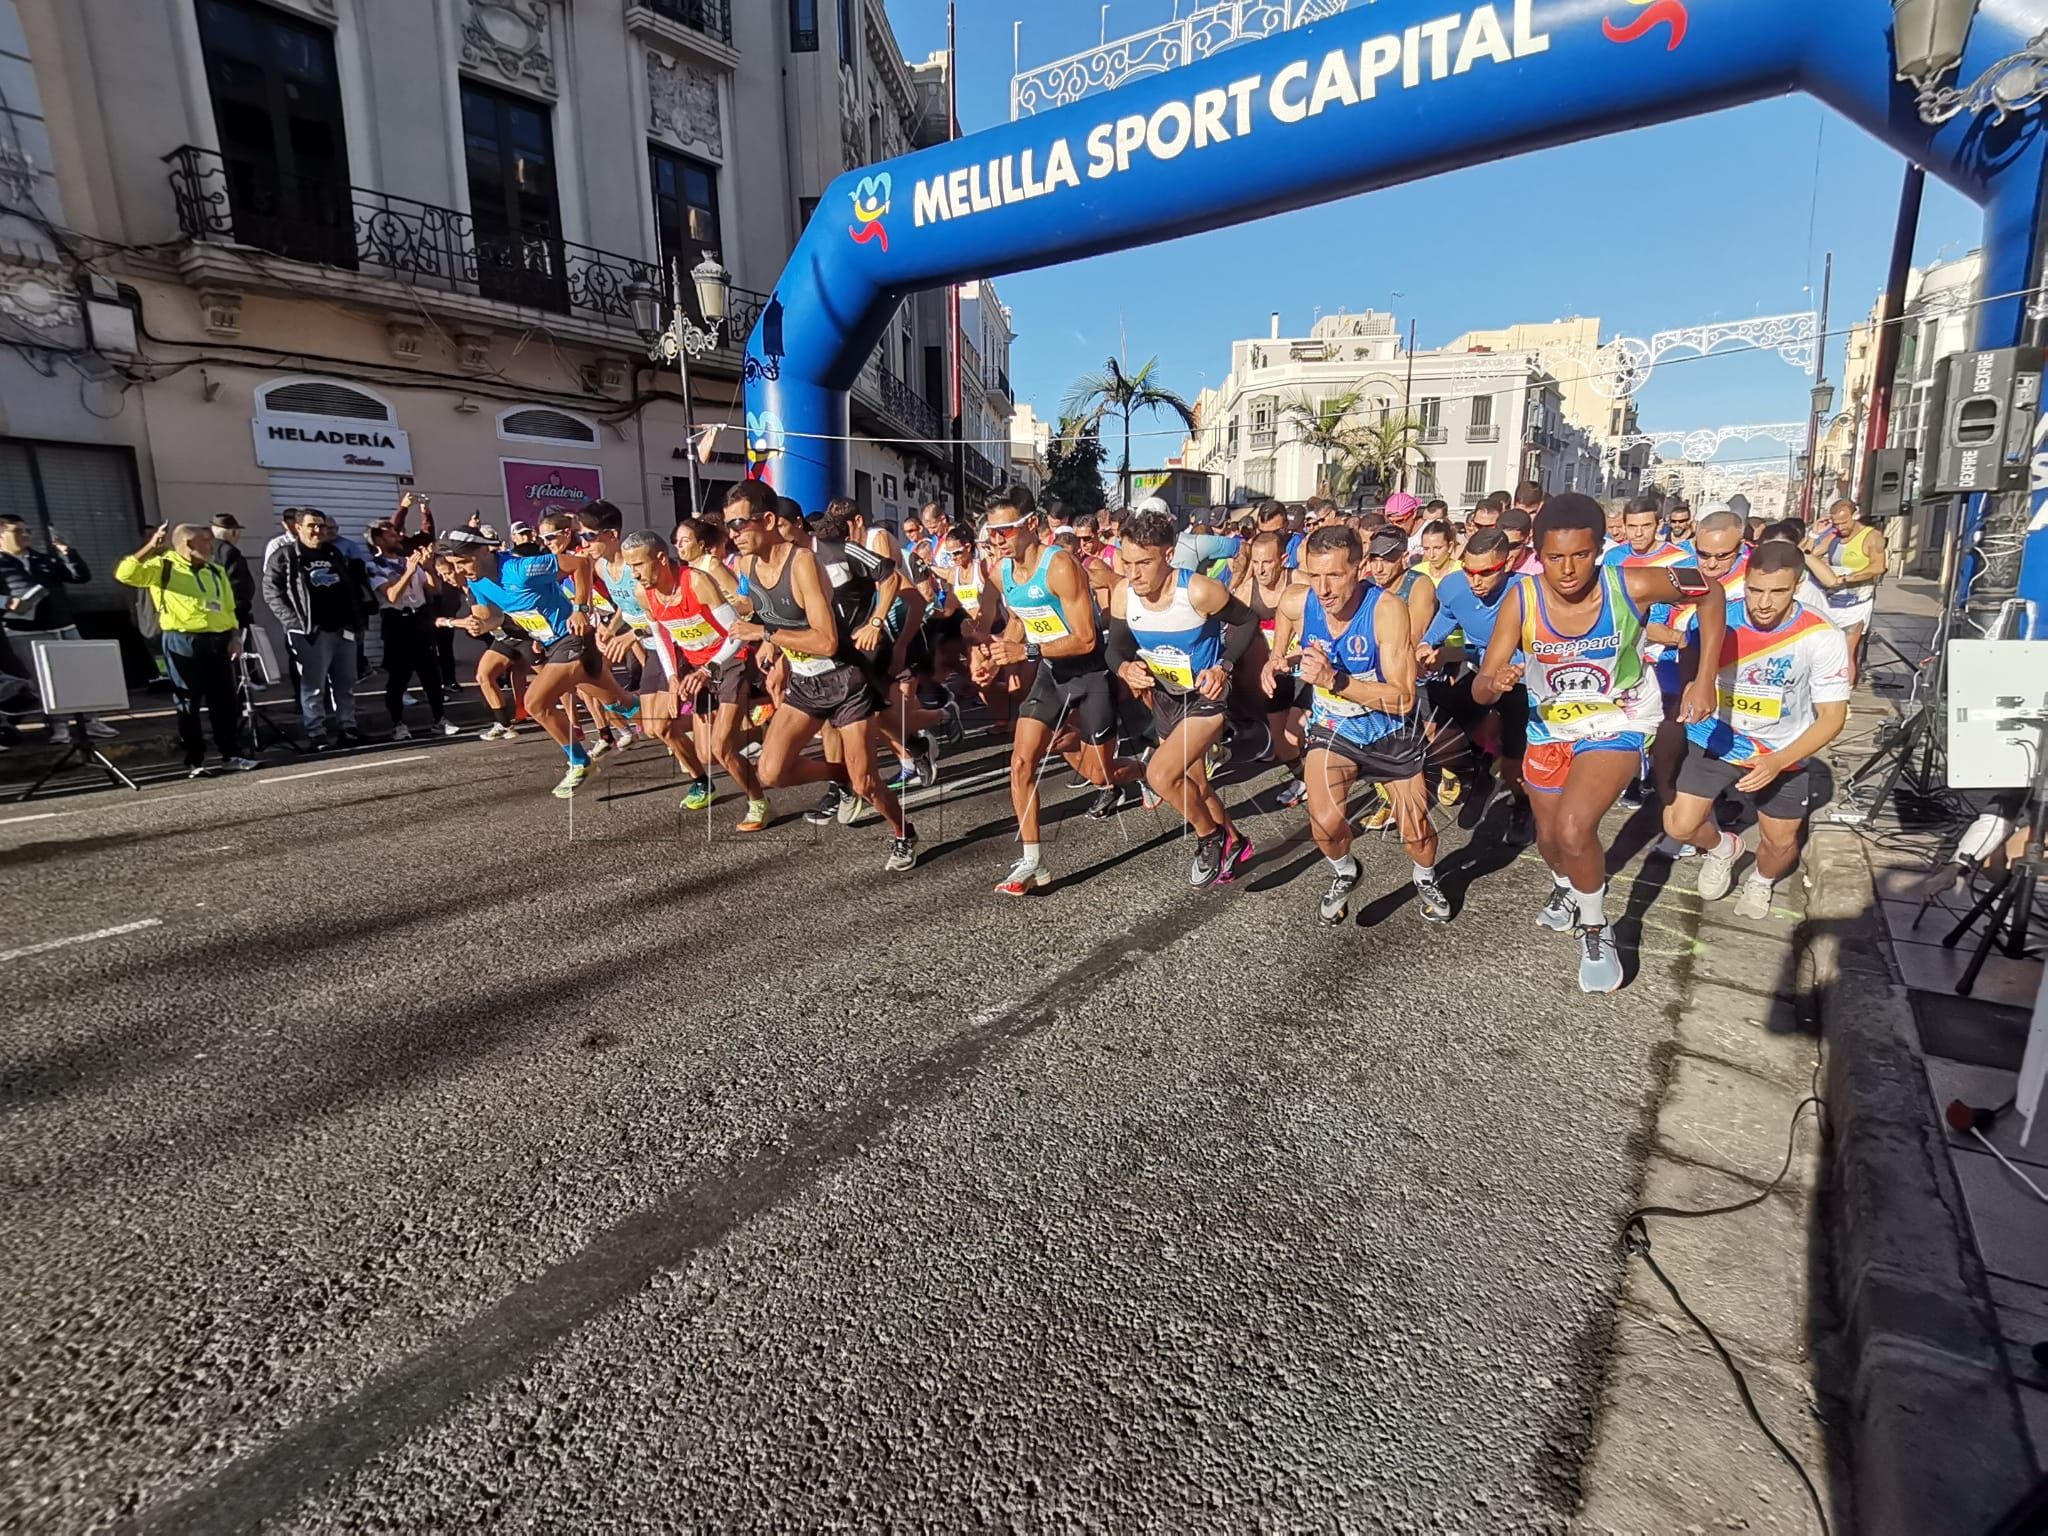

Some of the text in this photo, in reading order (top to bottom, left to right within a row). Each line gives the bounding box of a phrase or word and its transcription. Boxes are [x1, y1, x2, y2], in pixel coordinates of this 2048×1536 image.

[911, 0, 1550, 229] MELILLA SPORT CAPITAL
[1973, 352, 1995, 394] DEXFIRE
[268, 426, 396, 449] HELADERÍA
[1958, 449, 1979, 488] DEXFIRE
[680, 628, 703, 640] 453
[1531, 631, 1622, 656] Geeppard
[1556, 703, 1600, 721] 316
[1724, 696, 1763, 713] 394
